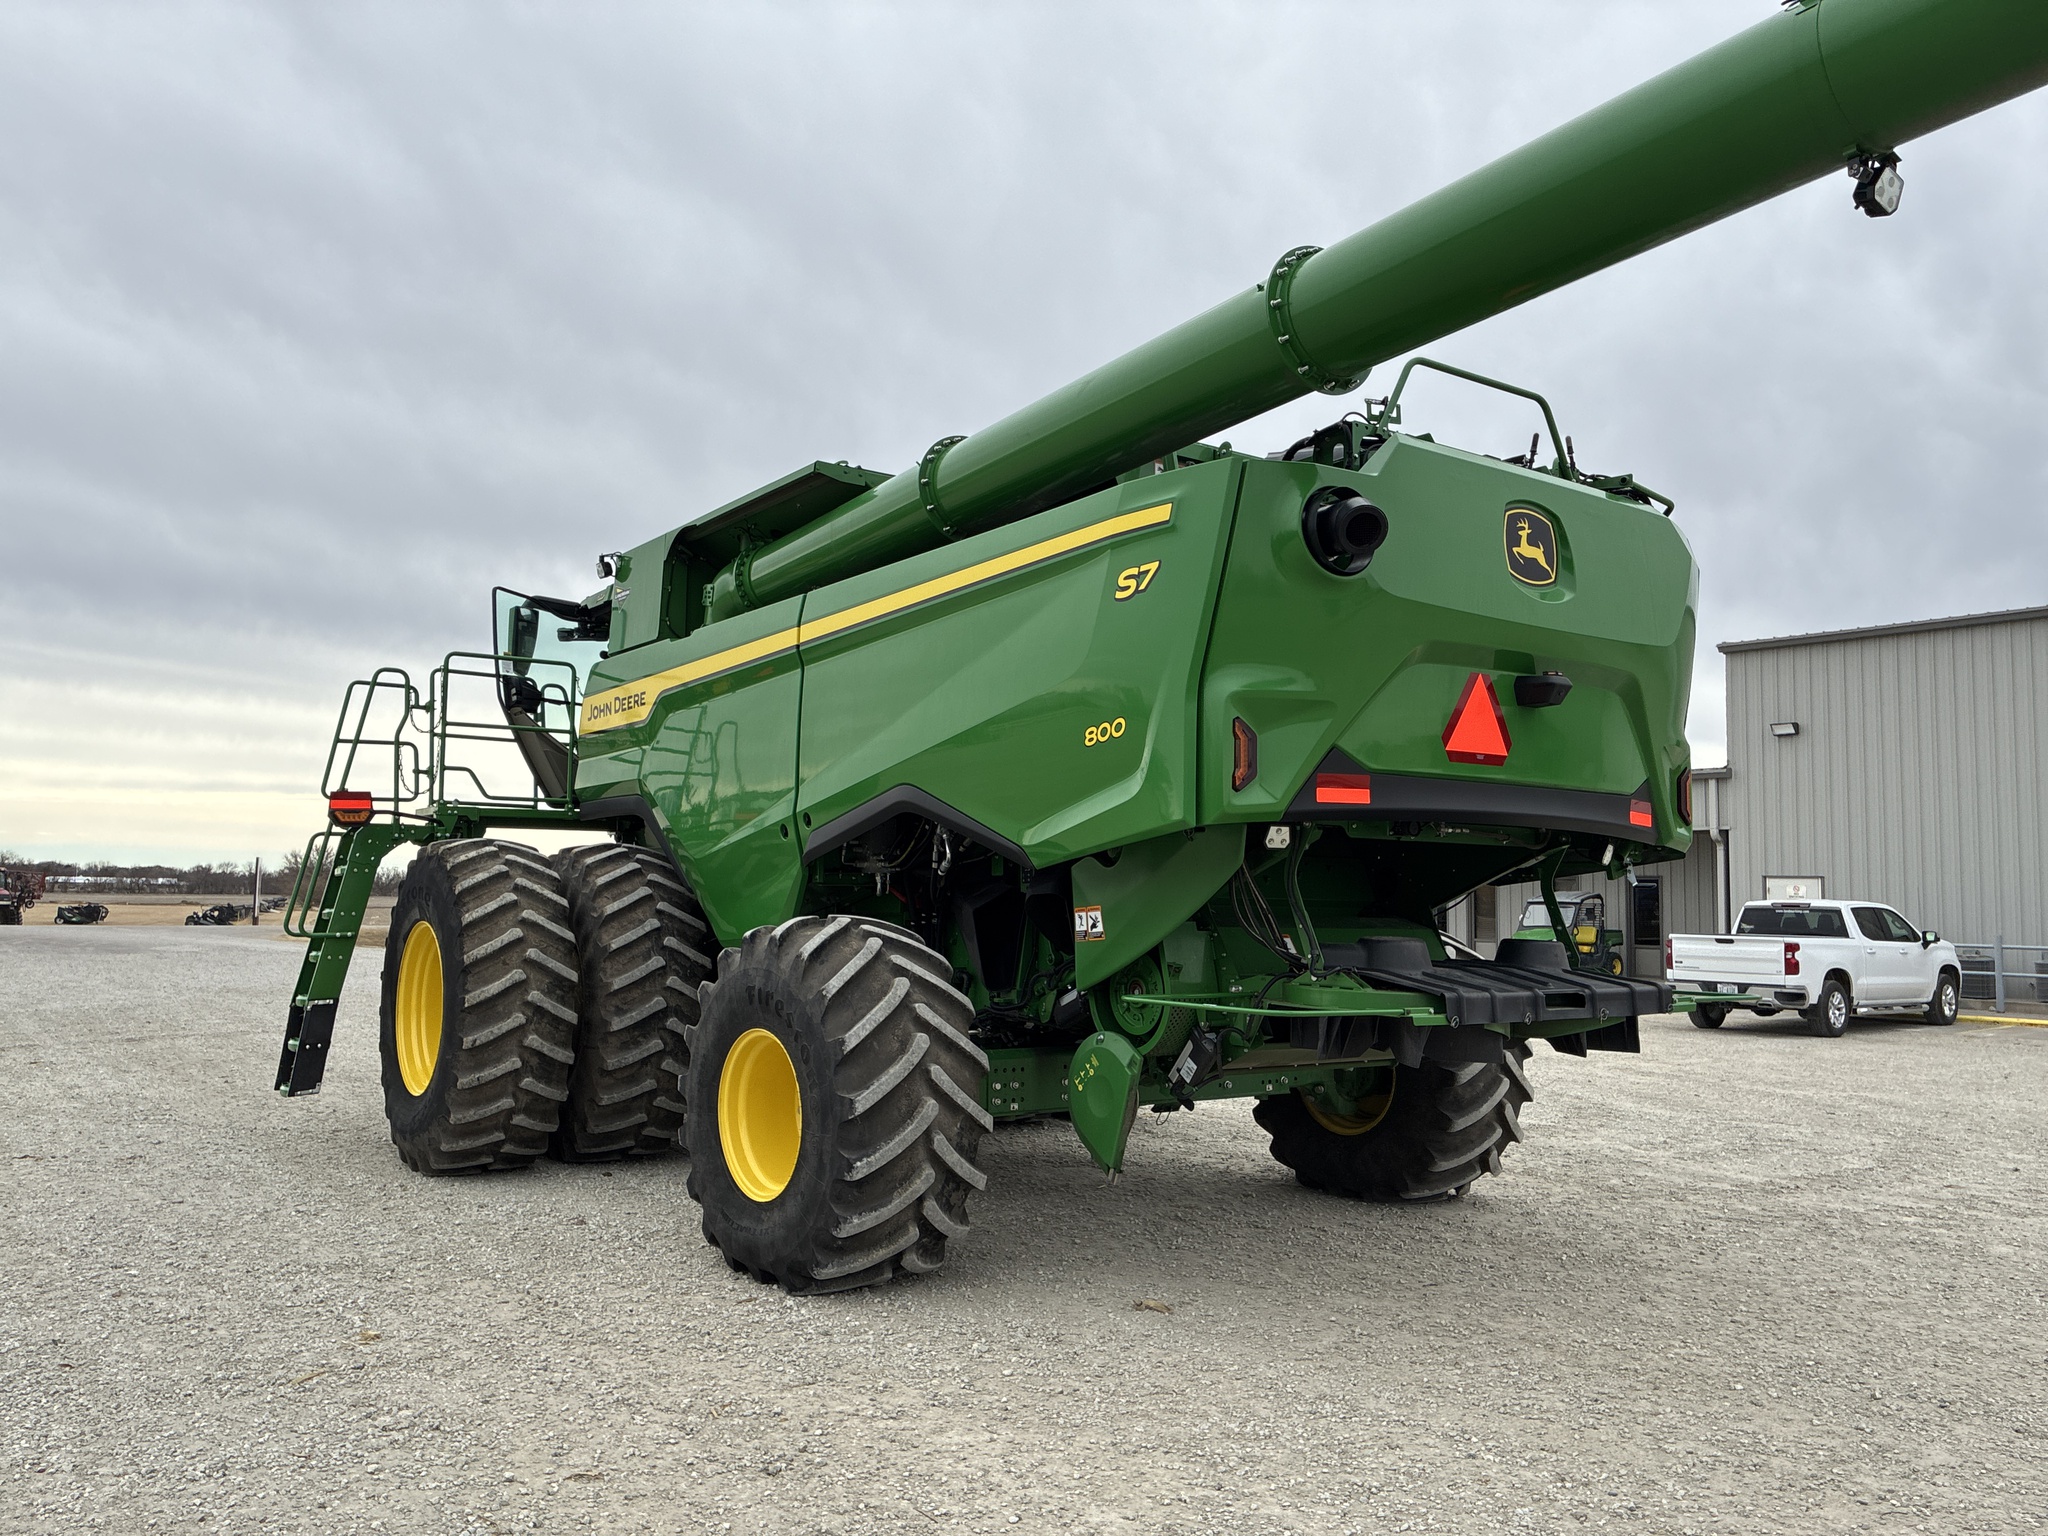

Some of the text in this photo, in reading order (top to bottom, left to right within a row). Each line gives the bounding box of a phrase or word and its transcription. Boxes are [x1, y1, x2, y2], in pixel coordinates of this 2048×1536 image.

[1114, 560, 1161, 601] S7
[587, 691, 647, 722] JOHN DEERE
[1084, 716, 1126, 747] 800
